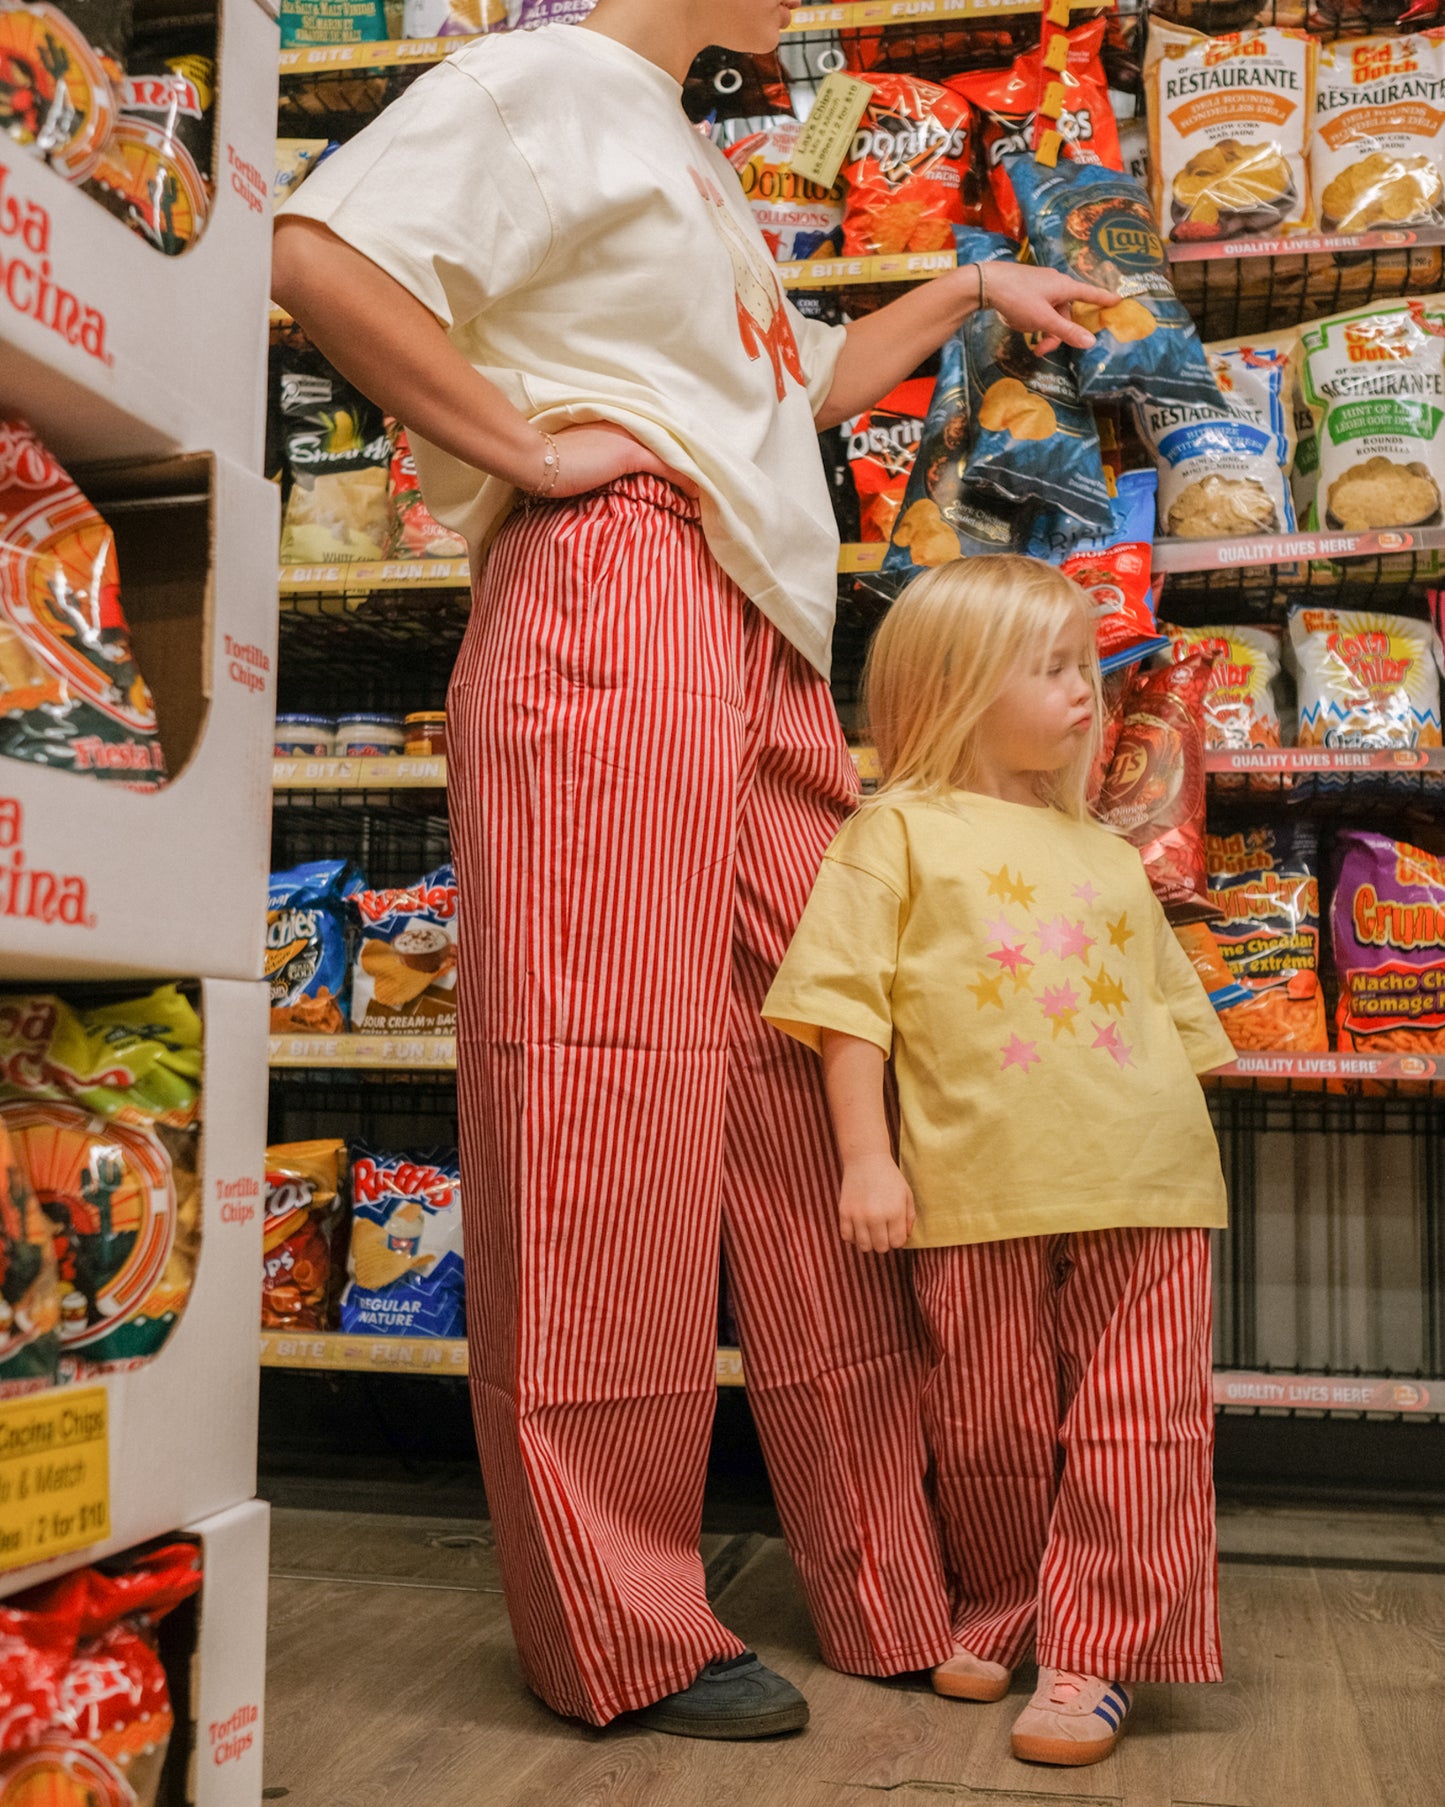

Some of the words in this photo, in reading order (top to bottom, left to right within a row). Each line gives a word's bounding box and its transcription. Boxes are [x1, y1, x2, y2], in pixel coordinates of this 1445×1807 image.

[794, 7, 844, 24] BITE
[892, 0, 936, 16] FUN
[306, 47, 354, 64] BITE
[397, 41, 438, 57] FUN
[1167, 67, 1300, 99] RESTAURANTE
[1353, 60, 1418, 85] Dutch
[813, 86, 834, 121] Chips
[849, 128, 967, 162] Doritos
[227, 143, 267, 198] Tortilla
[231, 172, 264, 214] Chips
[1106, 228, 1160, 255] Lay's
[1223, 240, 1280, 256] QUALITY
[1281, 238, 1321, 252] LIVES
[1324, 236, 1361, 249] HERE
[810, 261, 863, 278] BITE
[907, 255, 953, 271] FUN
[0, 257, 105, 359] cina
[1362, 436, 1404, 446] ROUNDS
[1218, 545, 1275, 563] QUALITY
[1277, 540, 1317, 557] LIVES
[1318, 537, 1356, 552] HERE
[292, 567, 339, 582] BITE
[381, 564, 423, 579] FUN
[430, 563, 451, 577] IN
[224, 634, 271, 672] Tortilla
[1326, 630, 1389, 665] Corn
[229, 660, 266, 693] Chips
[305, 762, 354, 778] BITE
[396, 763, 440, 778] FUN
[1231, 754, 1288, 768] QUALITY
[1292, 754, 1331, 768] LIVES
[1334, 754, 1371, 766] HERE
[1207, 850, 1274, 876] Dutch
[1247, 932, 1314, 952] Cheddar
[1352, 974, 1418, 993] Nacho
[363, 1016, 387, 1029] SOUR
[388, 1015, 425, 1028] CREAM
[289, 1040, 338, 1057] BITE
[381, 1041, 425, 1058] FUN
[432, 1041, 455, 1058] IN
[1236, 1055, 1294, 1075] QUALITY
[1297, 1055, 1337, 1074] LIVES
[1340, 1056, 1379, 1074] HERE
[215, 1178, 260, 1201] Tortilla
[219, 1201, 255, 1226] Chips
[359, 1298, 422, 1314] REGULAR
[358, 1312, 414, 1327] NATURE
[277, 1340, 326, 1358] BITE
[371, 1344, 413, 1362] FUN
[422, 1347, 442, 1364] IN
[1227, 1383, 1285, 1400] QUALITY
[1288, 1385, 1329, 1403] LIVES
[1332, 1387, 1371, 1404] HERE
[208, 1705, 259, 1743] Tortilla
[213, 1732, 253, 1767] Chips
